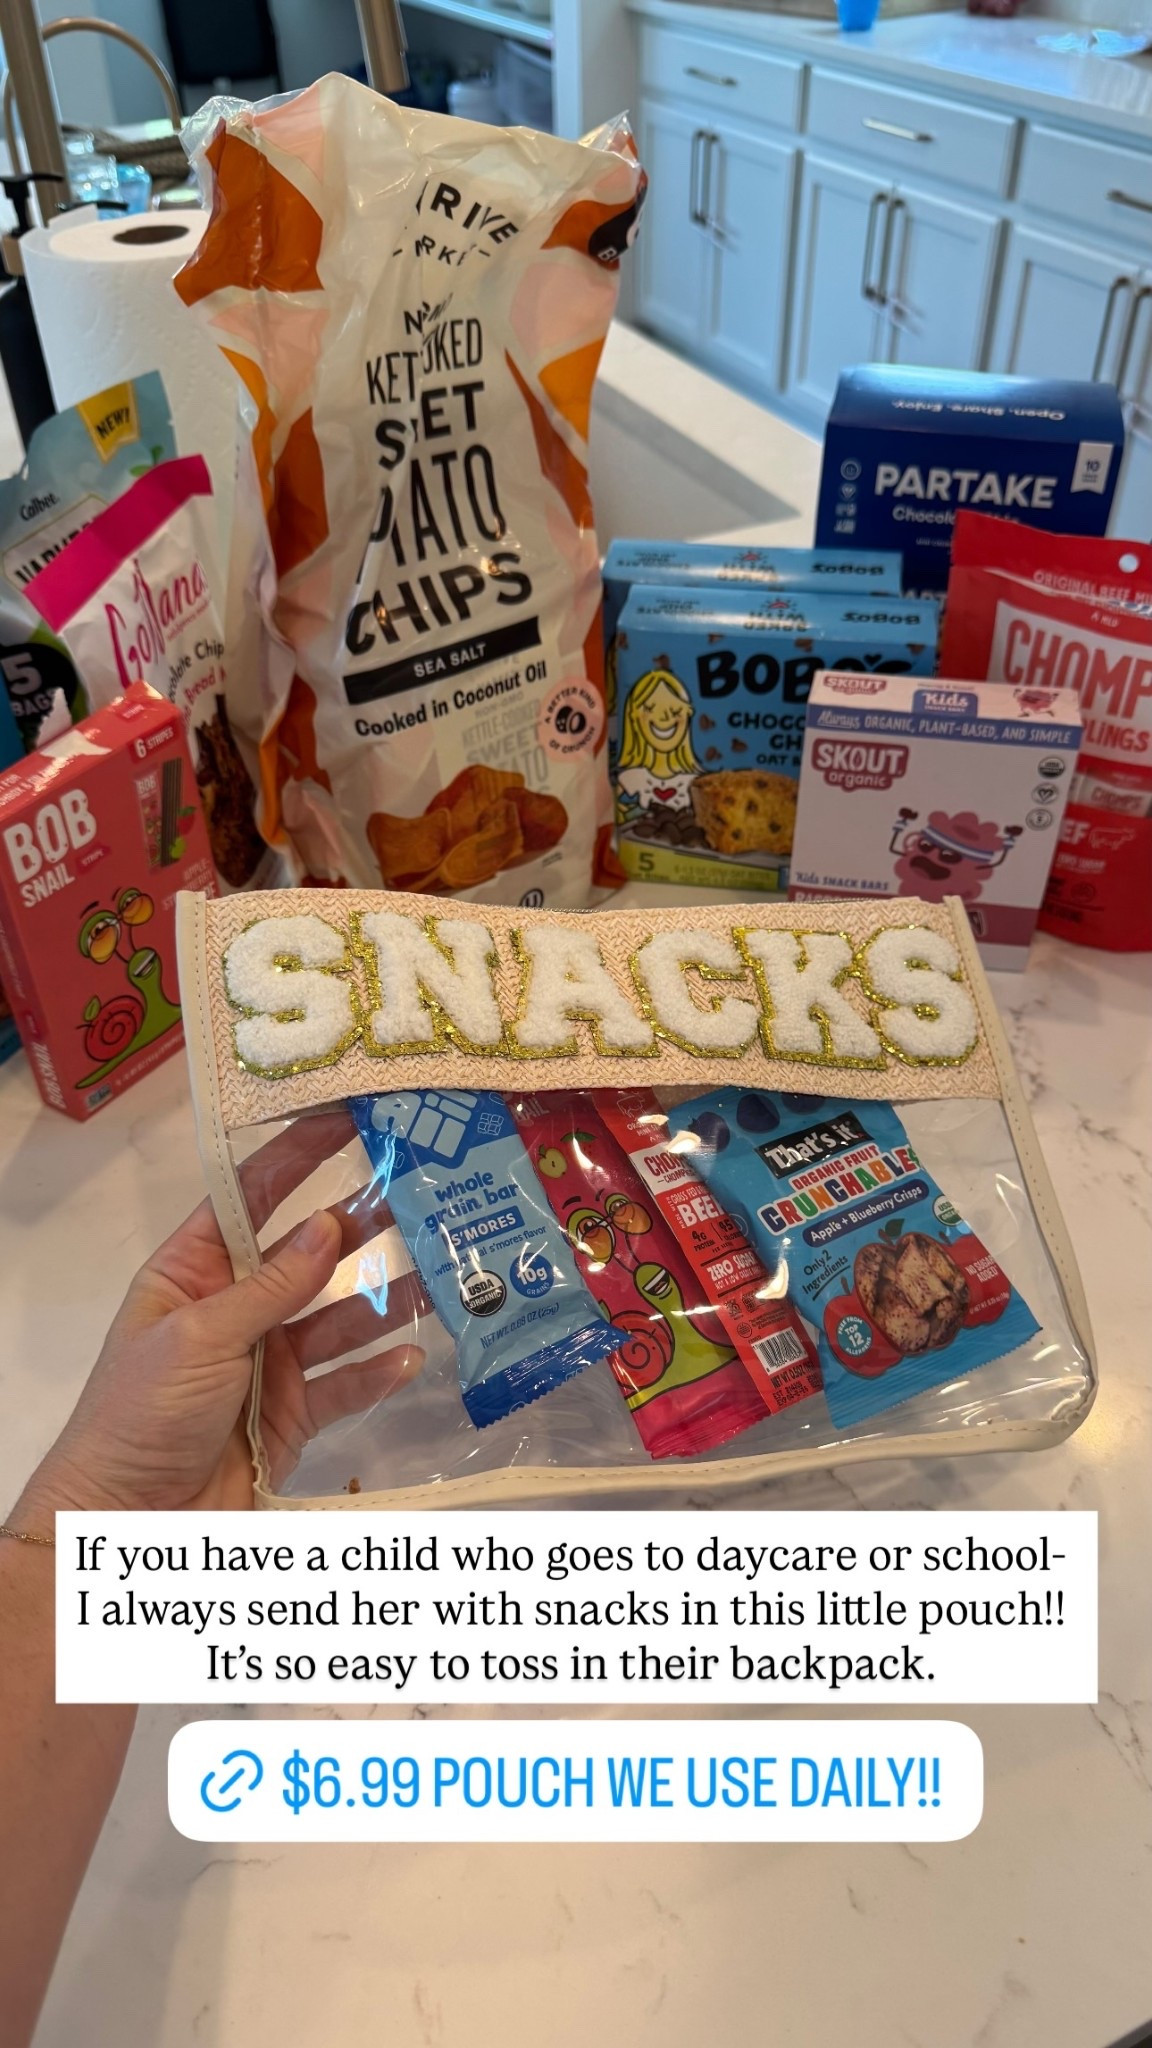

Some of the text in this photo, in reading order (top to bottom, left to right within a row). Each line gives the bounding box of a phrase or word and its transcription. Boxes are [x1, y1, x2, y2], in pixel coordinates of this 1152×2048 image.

[95, 407, 131, 439] NEW!
[875, 463, 1057, 509] PARTAKE
[1033, 570, 1096, 597] ORIGINAL
[346, 552, 532, 656] CHIPS
[1, 652, 42, 695] 5
[413, 655, 446, 678] SEA
[450, 643, 487, 667] SALT
[827, 676, 883, 689] SKOUT
[355, 661, 547, 737] Cooked in Coconut Oil
[922, 692, 969, 708] Kids
[134, 728, 174, 758] 6 STRIPES
[817, 710, 1072, 744] Always ORGANIC, PLANT-BASED, AND SIMPLE
[816, 742, 902, 774] SKOUT
[829, 769, 887, 789] organic
[3, 788, 97, 884] BOB
[638, 852, 654, 871] 5
[21, 863, 75, 908] SNAIL
[795, 870, 889, 891] Kids SNACK BARS
[222, 910, 983, 1080] SNACKS
[765, 1131, 838, 1169] That's
[791, 1145, 880, 1190] ORGANIC FRUIT
[434, 1171, 494, 1203] whole
[424, 1182, 519, 1235] grain bar
[810, 1186, 922, 1242] Apple + Blueberry Crisps
[451, 1213, 517, 1246] S'MORES
[434, 1225, 547, 1277] with s'mores flavor
[803, 1249, 833, 1276] Only 2
[517, 1267, 548, 1286] 10g
[706, 1259, 734, 1281] ZERO
[802, 1255, 849, 1294] Ingredients
[965, 1263, 977, 1276] NO
[468, 1278, 495, 1297] USDA
[526, 1281, 550, 1295] GRAINS
[480, 1332, 495, 1349] NET
[496, 1326, 510, 1340] WT.
[527, 1311, 538, 1323] OZ
[838, 1316, 863, 1335] FREE FROM
[844, 1324, 859, 1335] TOP
[849, 1332, 864, 1347] 12
